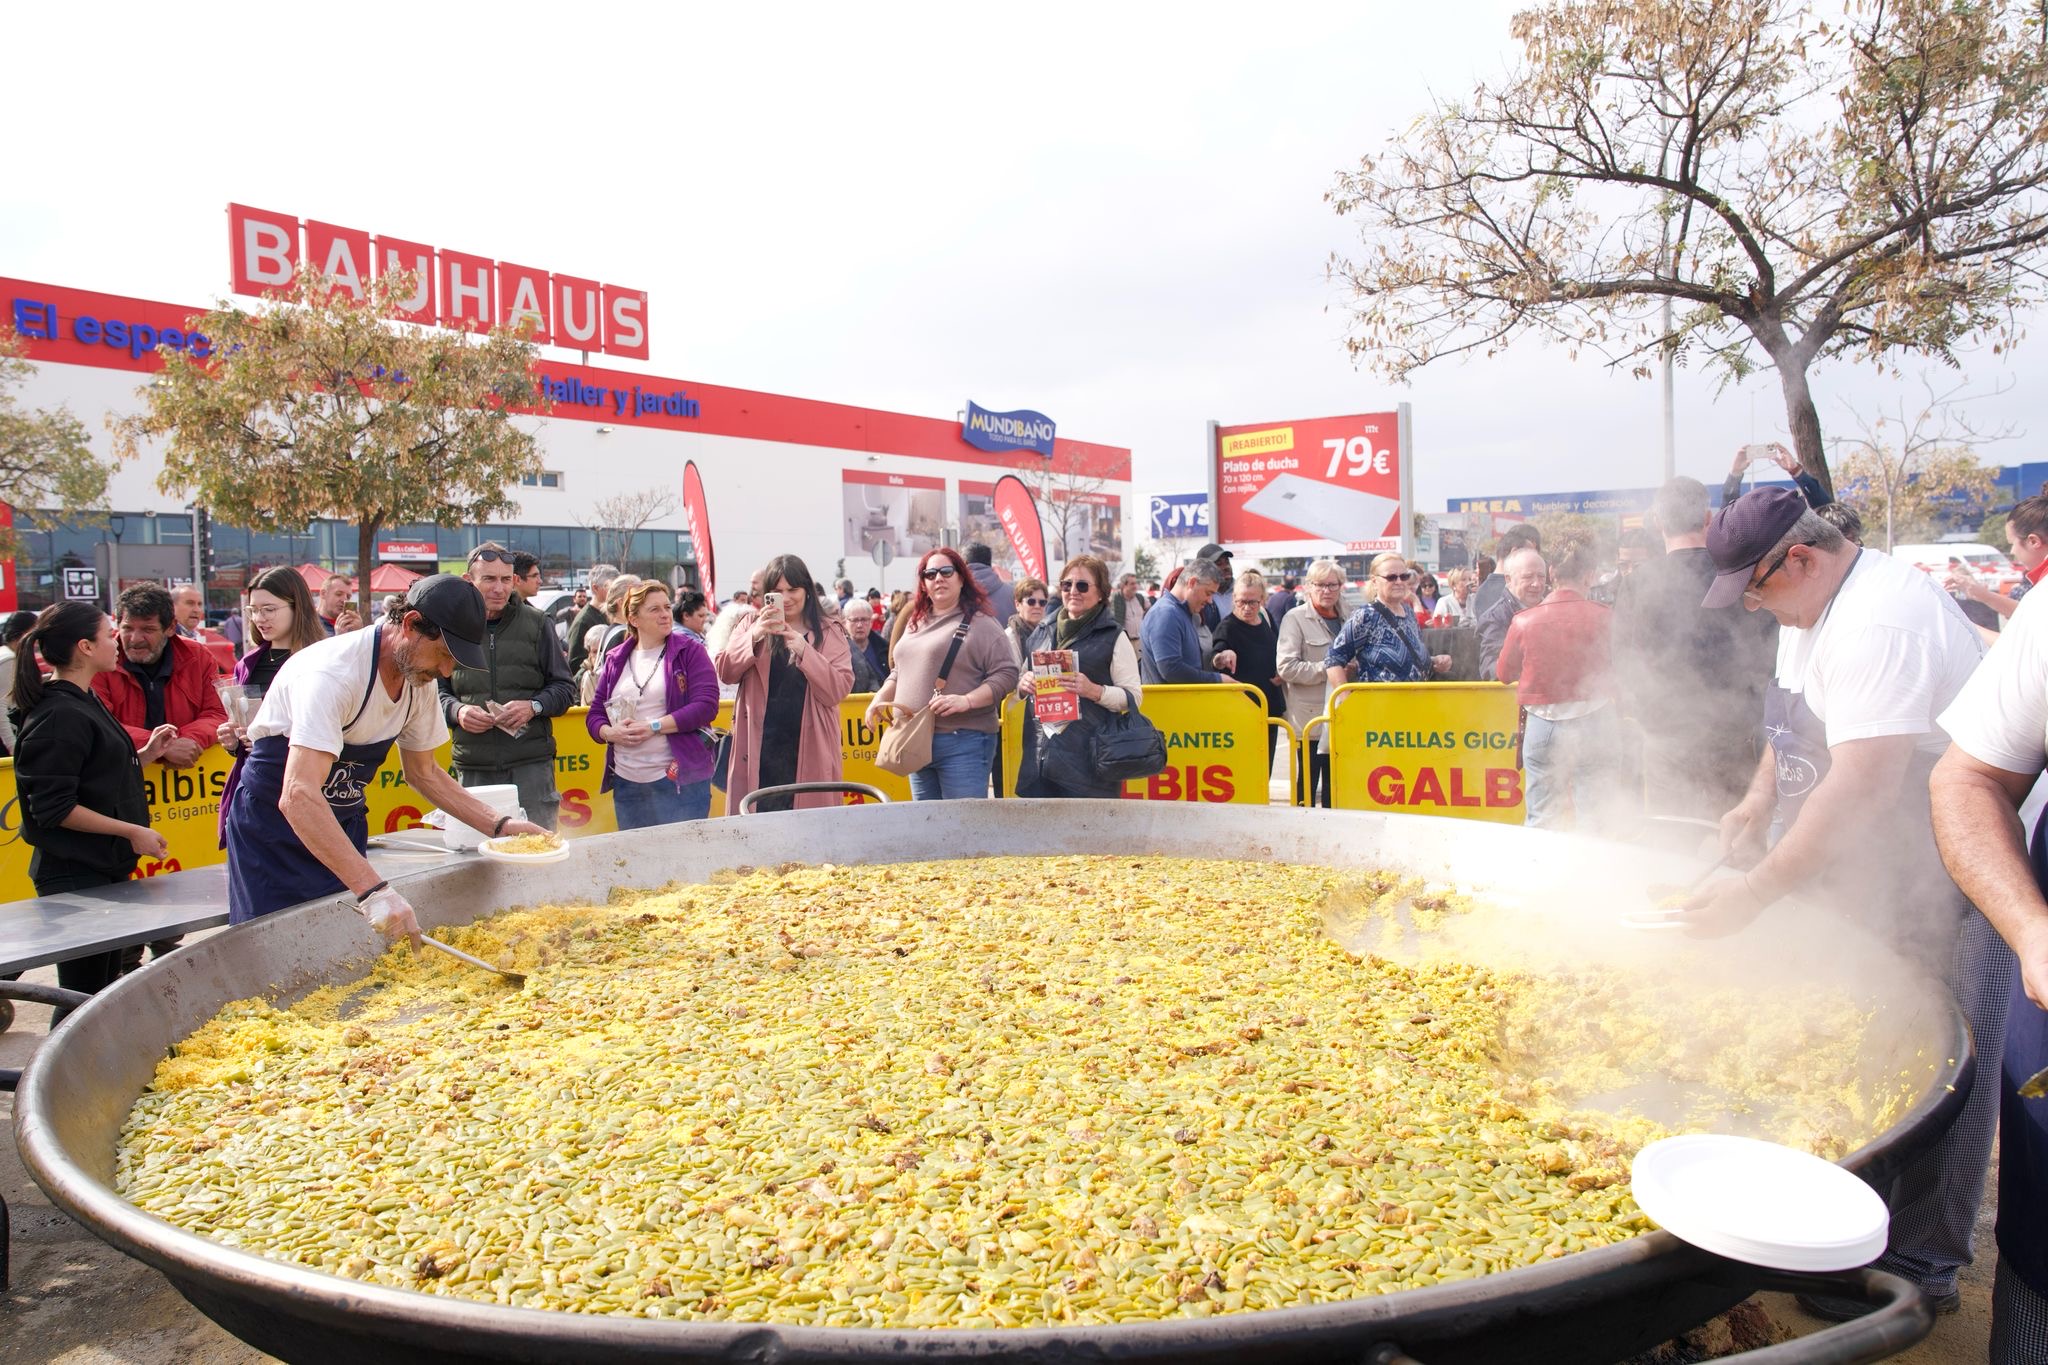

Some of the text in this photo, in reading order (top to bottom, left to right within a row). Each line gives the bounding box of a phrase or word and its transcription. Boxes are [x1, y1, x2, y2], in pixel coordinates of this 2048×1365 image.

[243, 218, 645, 348] BAUHAUS
[14, 298, 213, 360] El espec
[542, 374, 700, 418] taller y jardín
[970, 412, 1053, 441] MUNDIBAÑO
[1229, 433, 1287, 453] ¡REABIERTO!
[1223, 456, 1299, 473] Plato de ducha
[1322, 435, 1391, 478] 79€
[1223, 474, 1232, 483] 70
[1223, 485, 1237, 494] Con
[1167, 502, 1208, 527] JYS
[1460, 499, 1522, 513] IKEA
[1532, 501, 1570, 512] Muebles
[1572, 502, 1579, 511] y
[1002, 509, 1042, 580] BAUHAU
[1346, 541, 1396, 550] BAUHAUS
[1036, 678, 1057, 690] APE
[1038, 702, 1061, 713] BAU
[847, 718, 884, 747] lbi
[1167, 732, 1235, 748] ANTES
[1366, 731, 1519, 749] PAELLAS GIGA
[853, 749, 878, 761] Giga
[144, 766, 226, 805] albis
[1120, 765, 1235, 804] LBIS
[1367, 765, 1523, 807] GALB
[168, 802, 221, 821] Gigante
